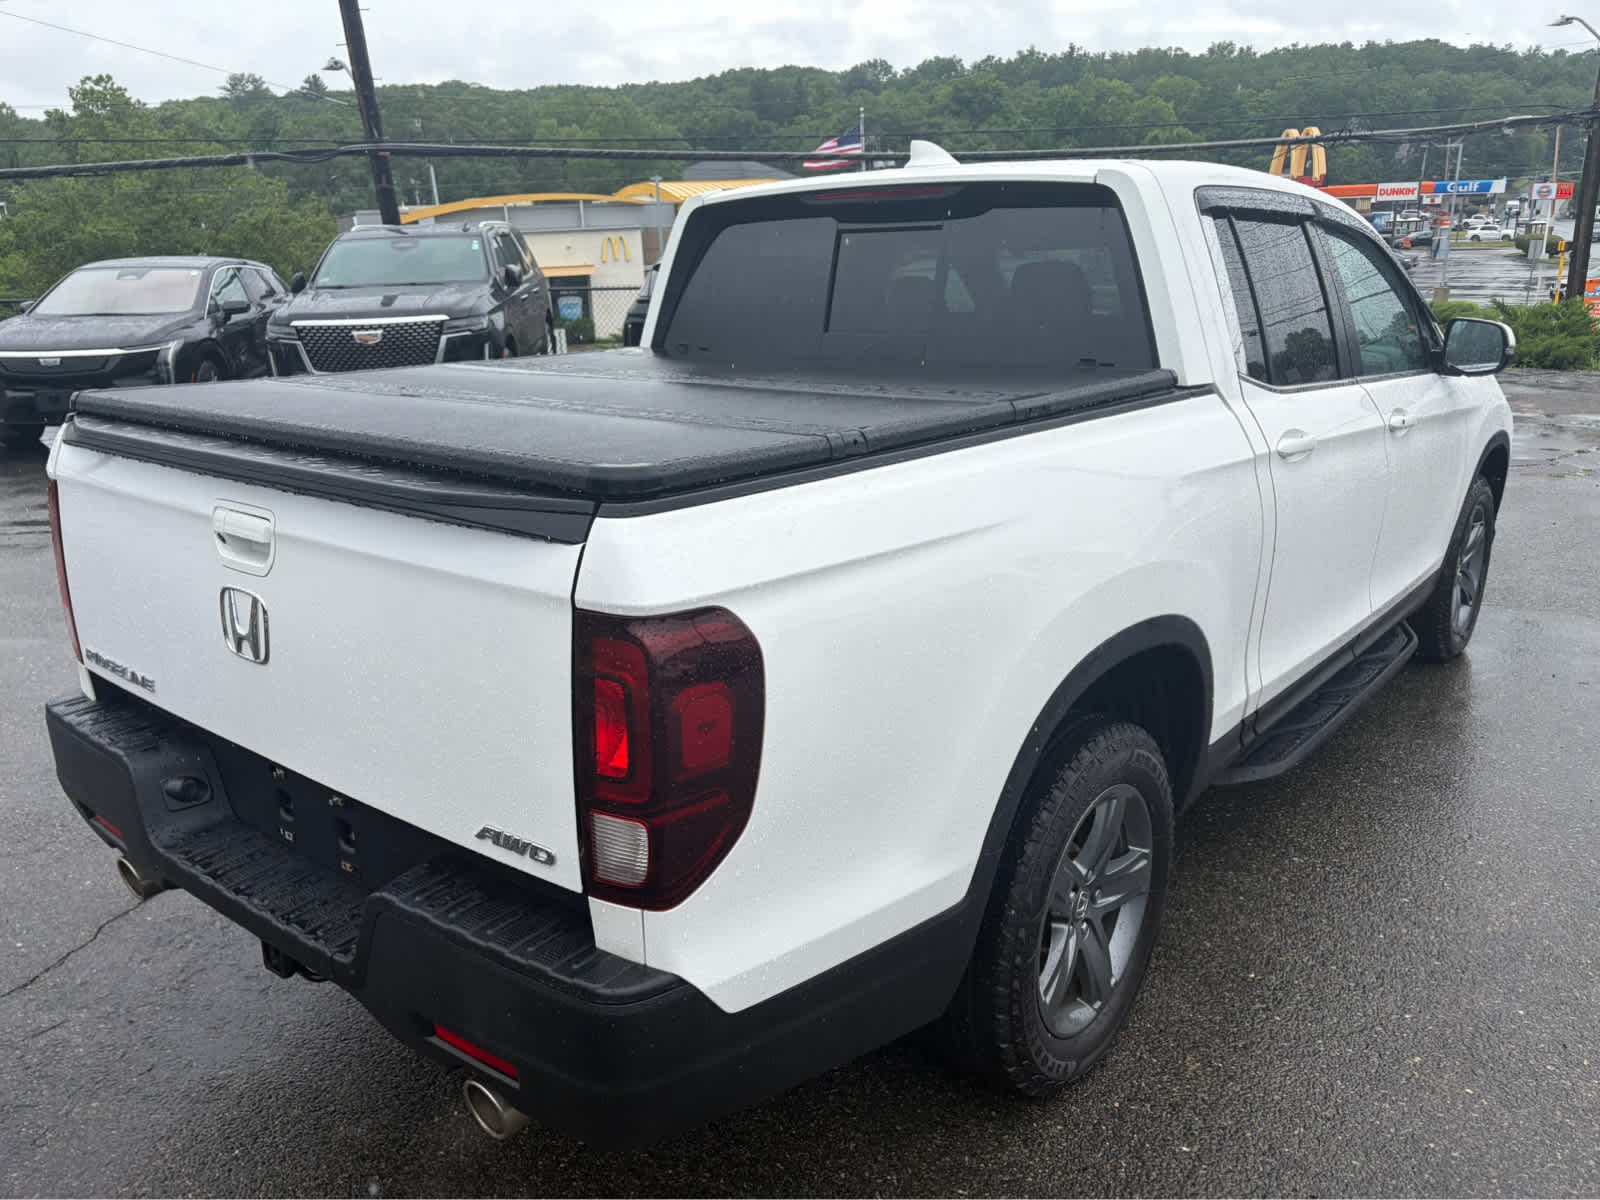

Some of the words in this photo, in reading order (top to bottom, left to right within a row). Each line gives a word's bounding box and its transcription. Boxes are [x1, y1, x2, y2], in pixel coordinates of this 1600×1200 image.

[1378, 187, 1417, 197] DUNKIN'
[1447, 182, 1480, 193] Gulf
[475, 825, 556, 866] AWD
